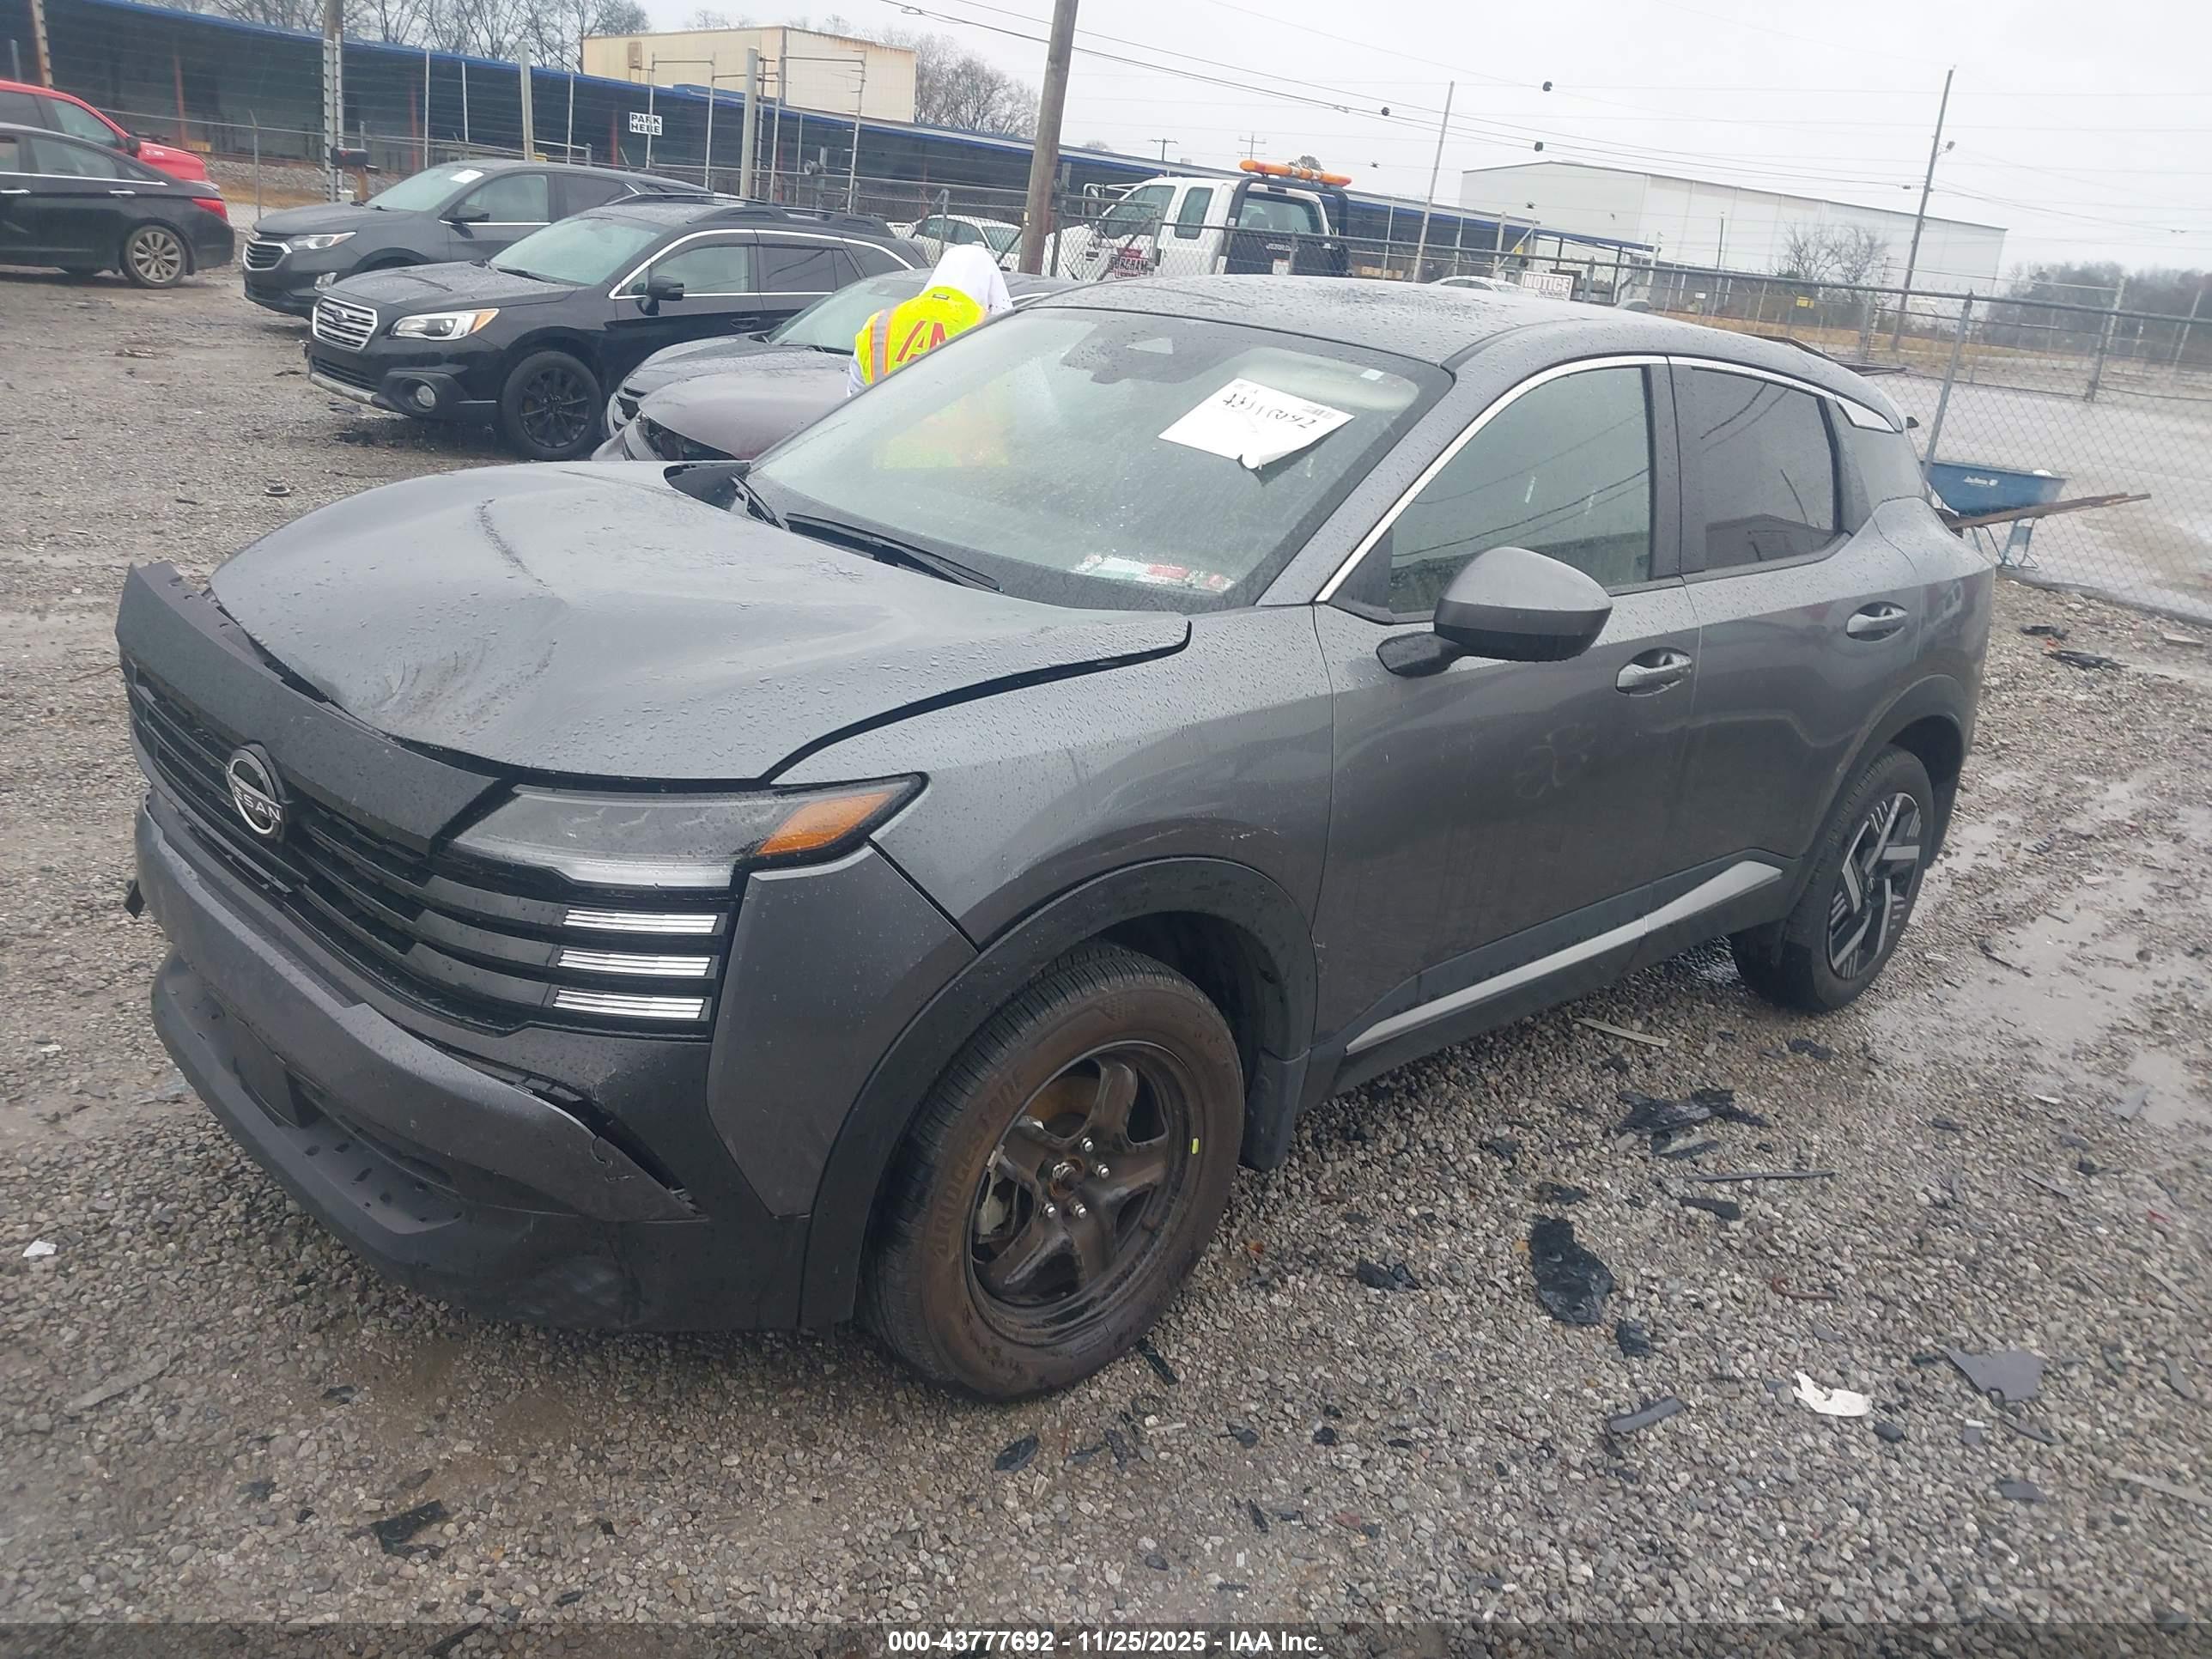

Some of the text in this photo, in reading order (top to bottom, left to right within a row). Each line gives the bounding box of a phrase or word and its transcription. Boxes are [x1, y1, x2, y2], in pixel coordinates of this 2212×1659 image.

[631, 113, 660, 125] PARK
[631, 123, 660, 134] HERE
[1524, 274, 1571, 292] NOTICE
